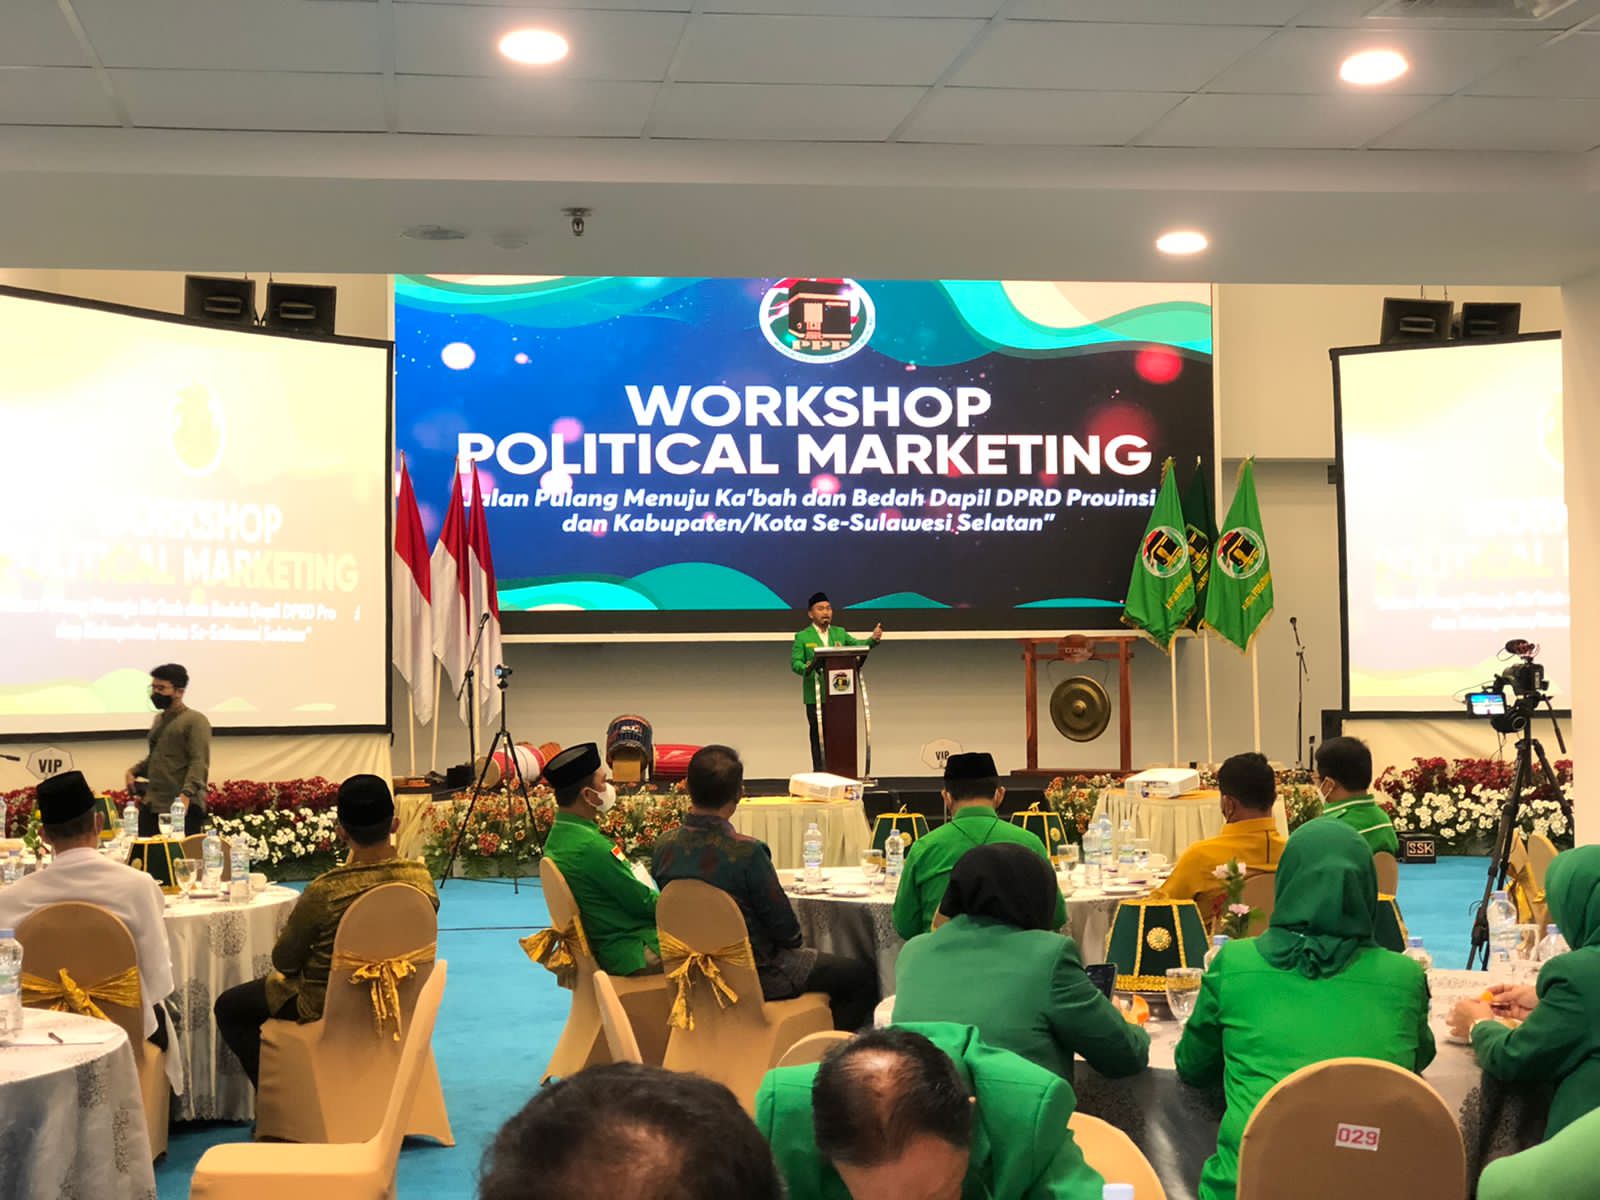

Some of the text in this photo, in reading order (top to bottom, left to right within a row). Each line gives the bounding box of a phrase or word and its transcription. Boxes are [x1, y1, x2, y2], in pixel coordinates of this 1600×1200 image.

[624, 384, 992, 429] WORKSHOP
[457, 431, 1152, 476] POLITICAL MARKETING
[534, 487, 619, 512] Pulang
[623, 488, 710, 512] Menuju
[714, 487, 797, 507] Ka'bah
[801, 487, 847, 507] dan
[851, 488, 925, 507] Bedah
[929, 487, 992, 512] Dapil
[995, 488, 1062, 507] DPRD
[562, 513, 609, 533] dan
[613, 511, 808, 537] Kabupaten/Kota
[811, 512, 953, 532] Se-Sulawesi
[38, 759, 63, 773] VIP
[935, 750, 950, 761] VIP
[1409, 842, 1433, 854] SSK
[1338, 1127, 1378, 1146] 029
